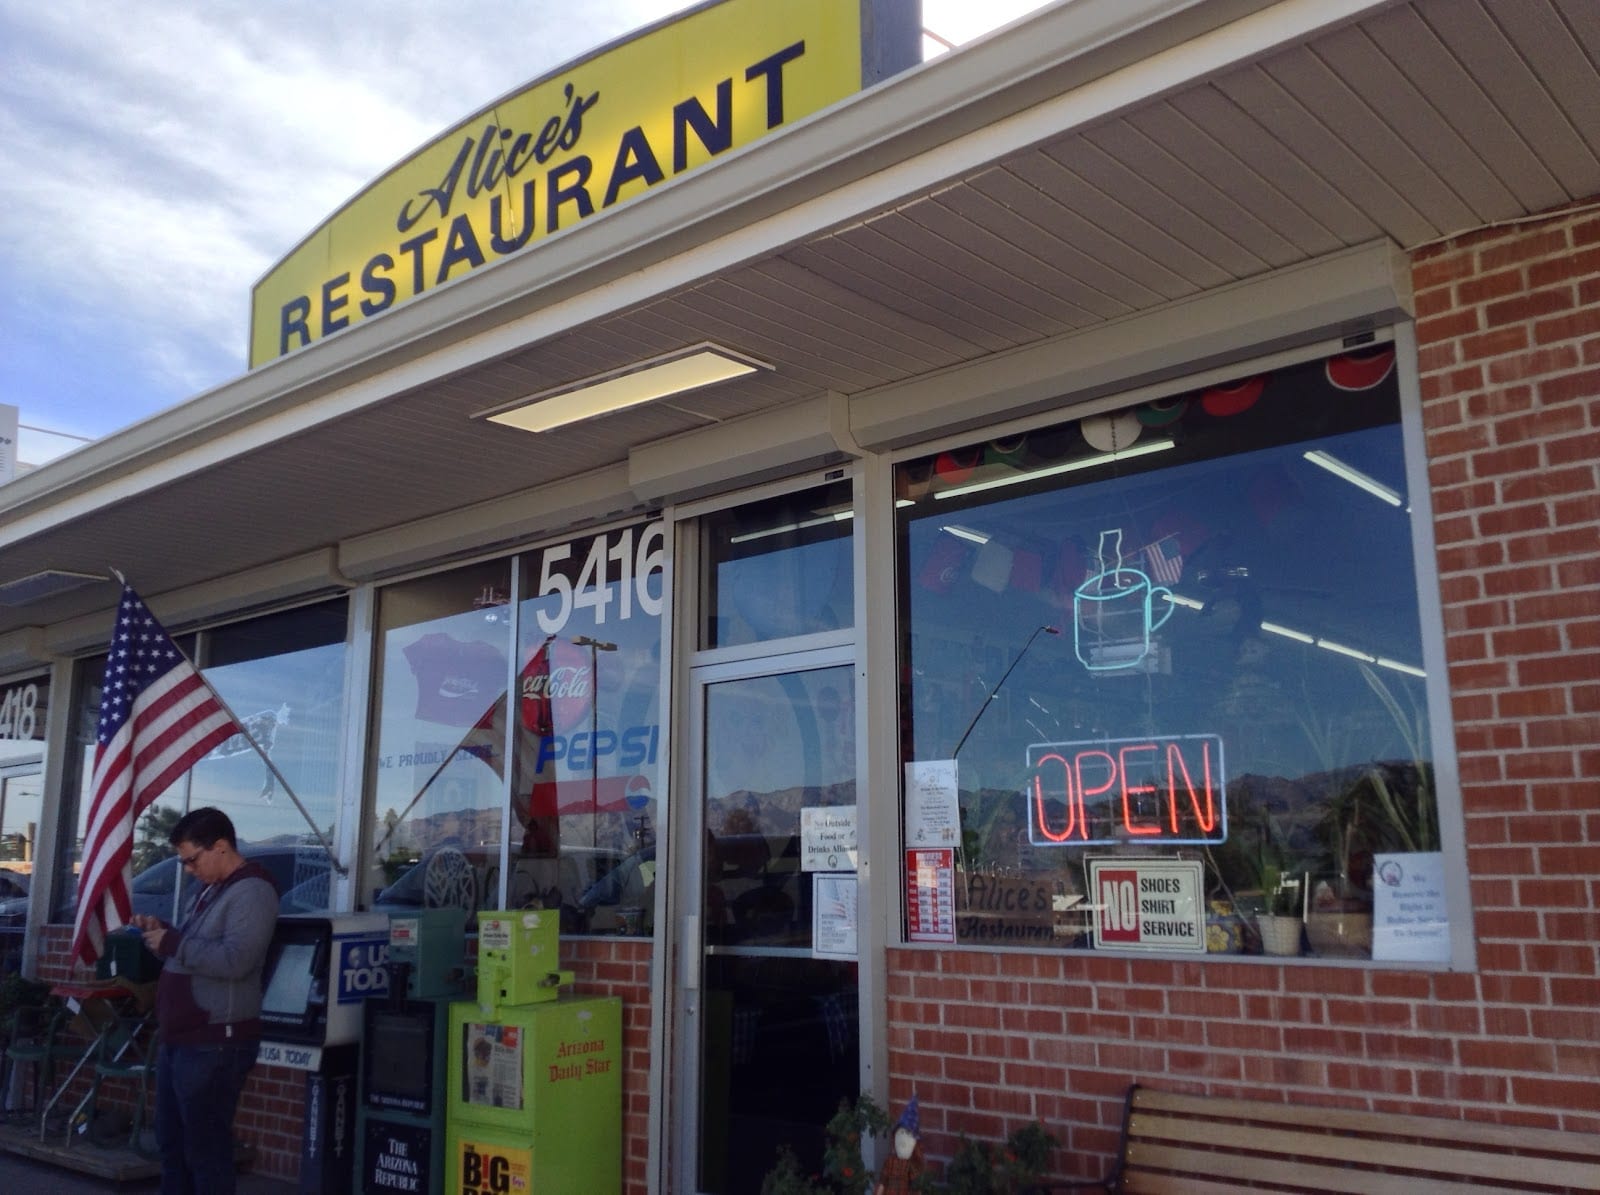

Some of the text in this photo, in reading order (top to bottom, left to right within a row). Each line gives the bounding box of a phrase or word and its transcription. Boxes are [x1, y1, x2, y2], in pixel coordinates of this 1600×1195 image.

[396, 82, 600, 233] Alice's
[280, 40, 806, 357] RESTAURANT
[536, 520, 664, 635] 5416
[398, 750, 449, 767] PROUDLY
[535, 725, 660, 775] PEPSI
[1035, 741, 1216, 842] OPEN
[820, 831, 837, 841] Food
[808, 844, 831, 854] Drinks
[967, 873, 1048, 912] Alice's
[1140, 878, 1181, 894] SHOES
[1102, 880, 1138, 933] NO
[1141, 899, 1177, 915] SHIRT
[1143, 920, 1196, 937] SERVICE
[343, 966, 388, 993] TOD
[264, 1047, 312, 1067] USA TODAY
[557, 1039, 605, 1059] Arizona
[549, 1058, 612, 1083] Daily Star
[387, 1138, 409, 1157] THE
[376, 1153, 418, 1175] ARIZONA
[374, 1169, 420, 1192] REPUBLIC
